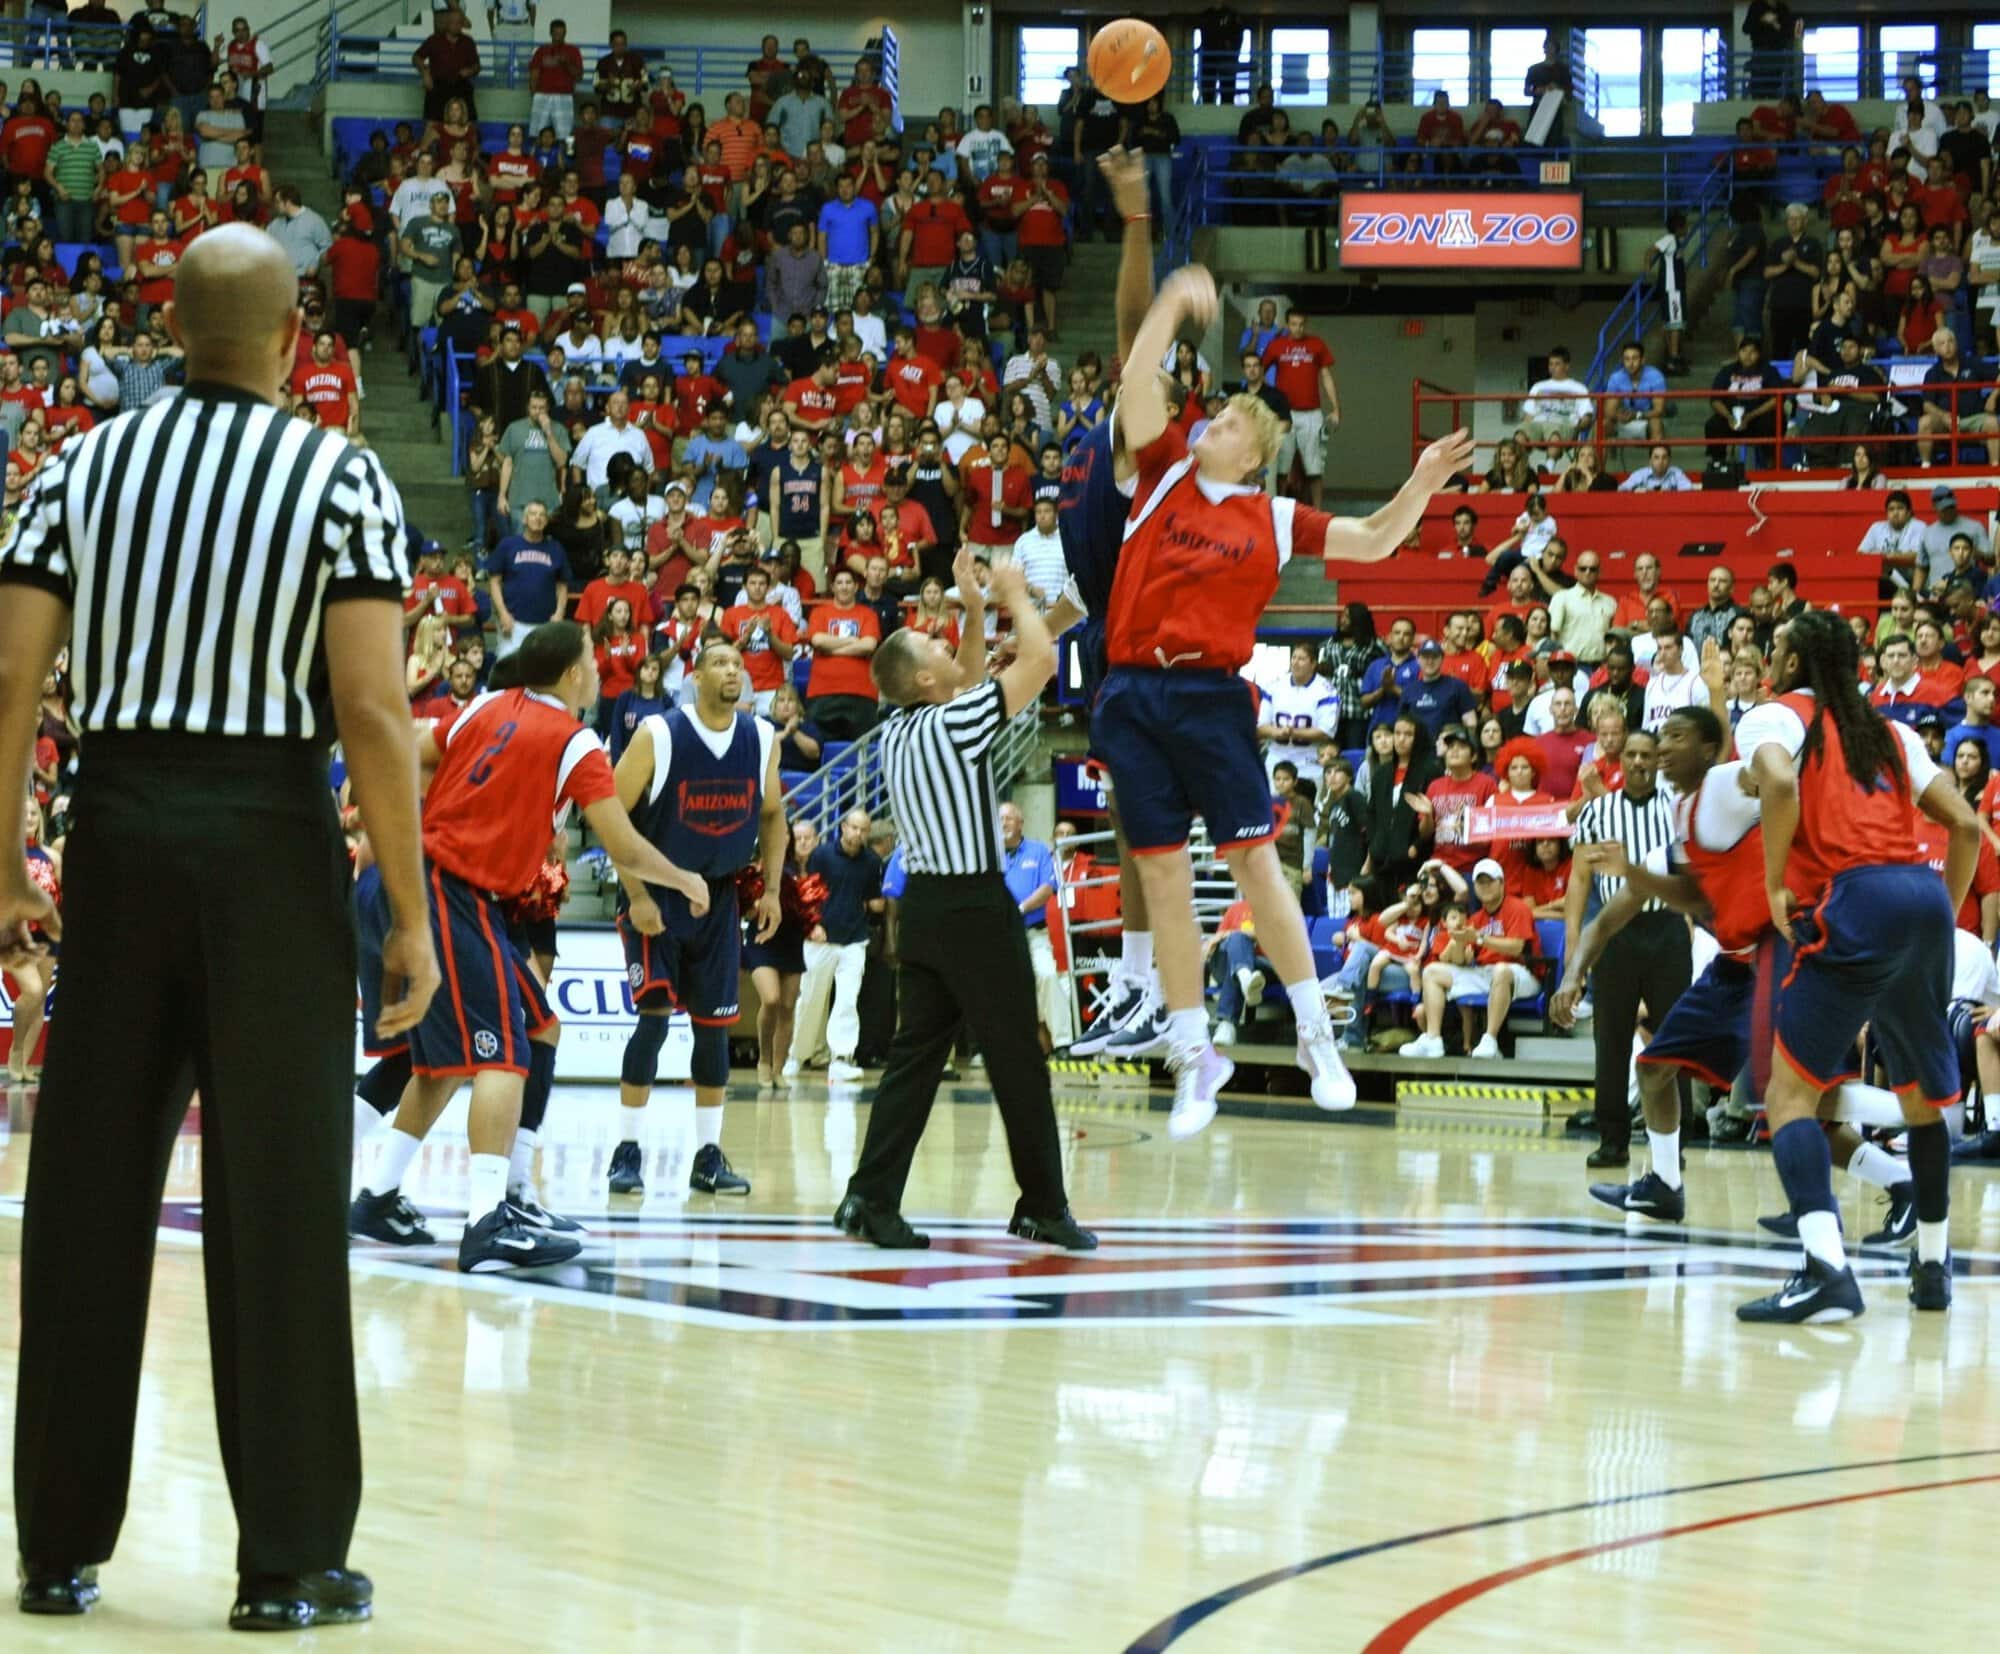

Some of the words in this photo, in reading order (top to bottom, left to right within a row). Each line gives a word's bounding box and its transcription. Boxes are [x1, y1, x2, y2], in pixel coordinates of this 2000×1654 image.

[1480, 213, 1578, 245] ZOO
[305, 374, 342, 391] ARIZONA
[1167, 531, 1243, 563] ARIZONA
[687, 794, 748, 811] ARIZONA
[557, 978, 689, 1016] CLU
